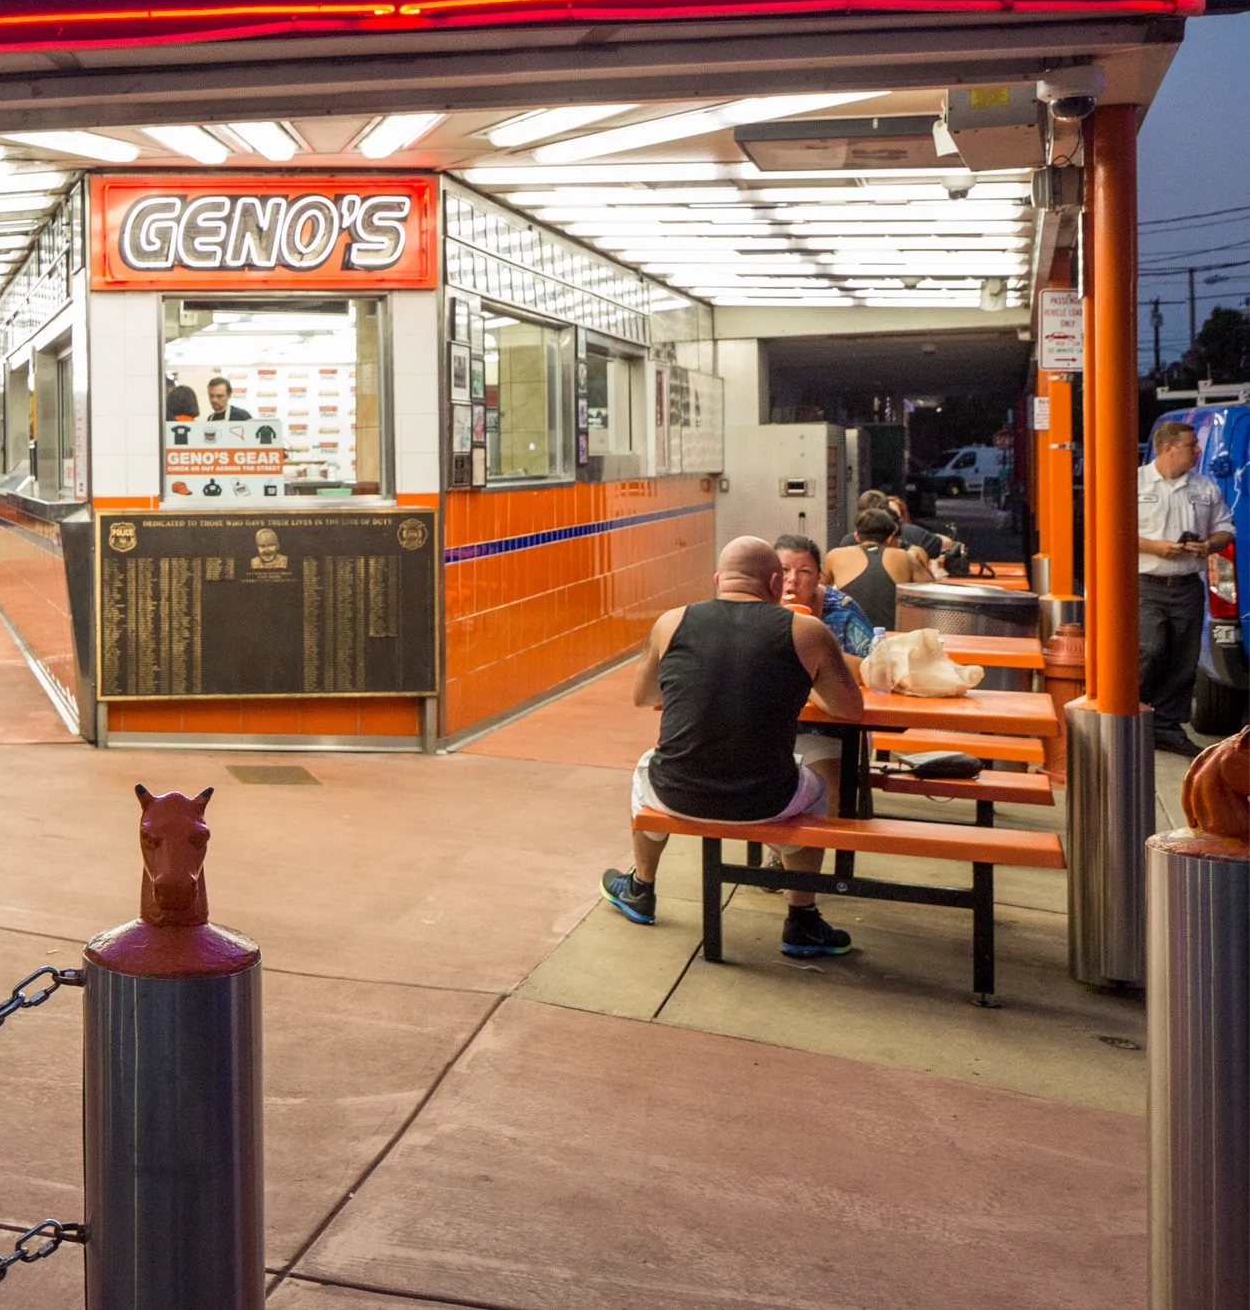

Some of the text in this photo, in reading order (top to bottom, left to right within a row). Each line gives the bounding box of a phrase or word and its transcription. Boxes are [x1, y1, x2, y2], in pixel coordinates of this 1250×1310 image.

[120, 194, 411, 271] GENO'S
[167, 452, 280, 465] GENO'S GEAR
[111, 528, 135, 537] POLICE
